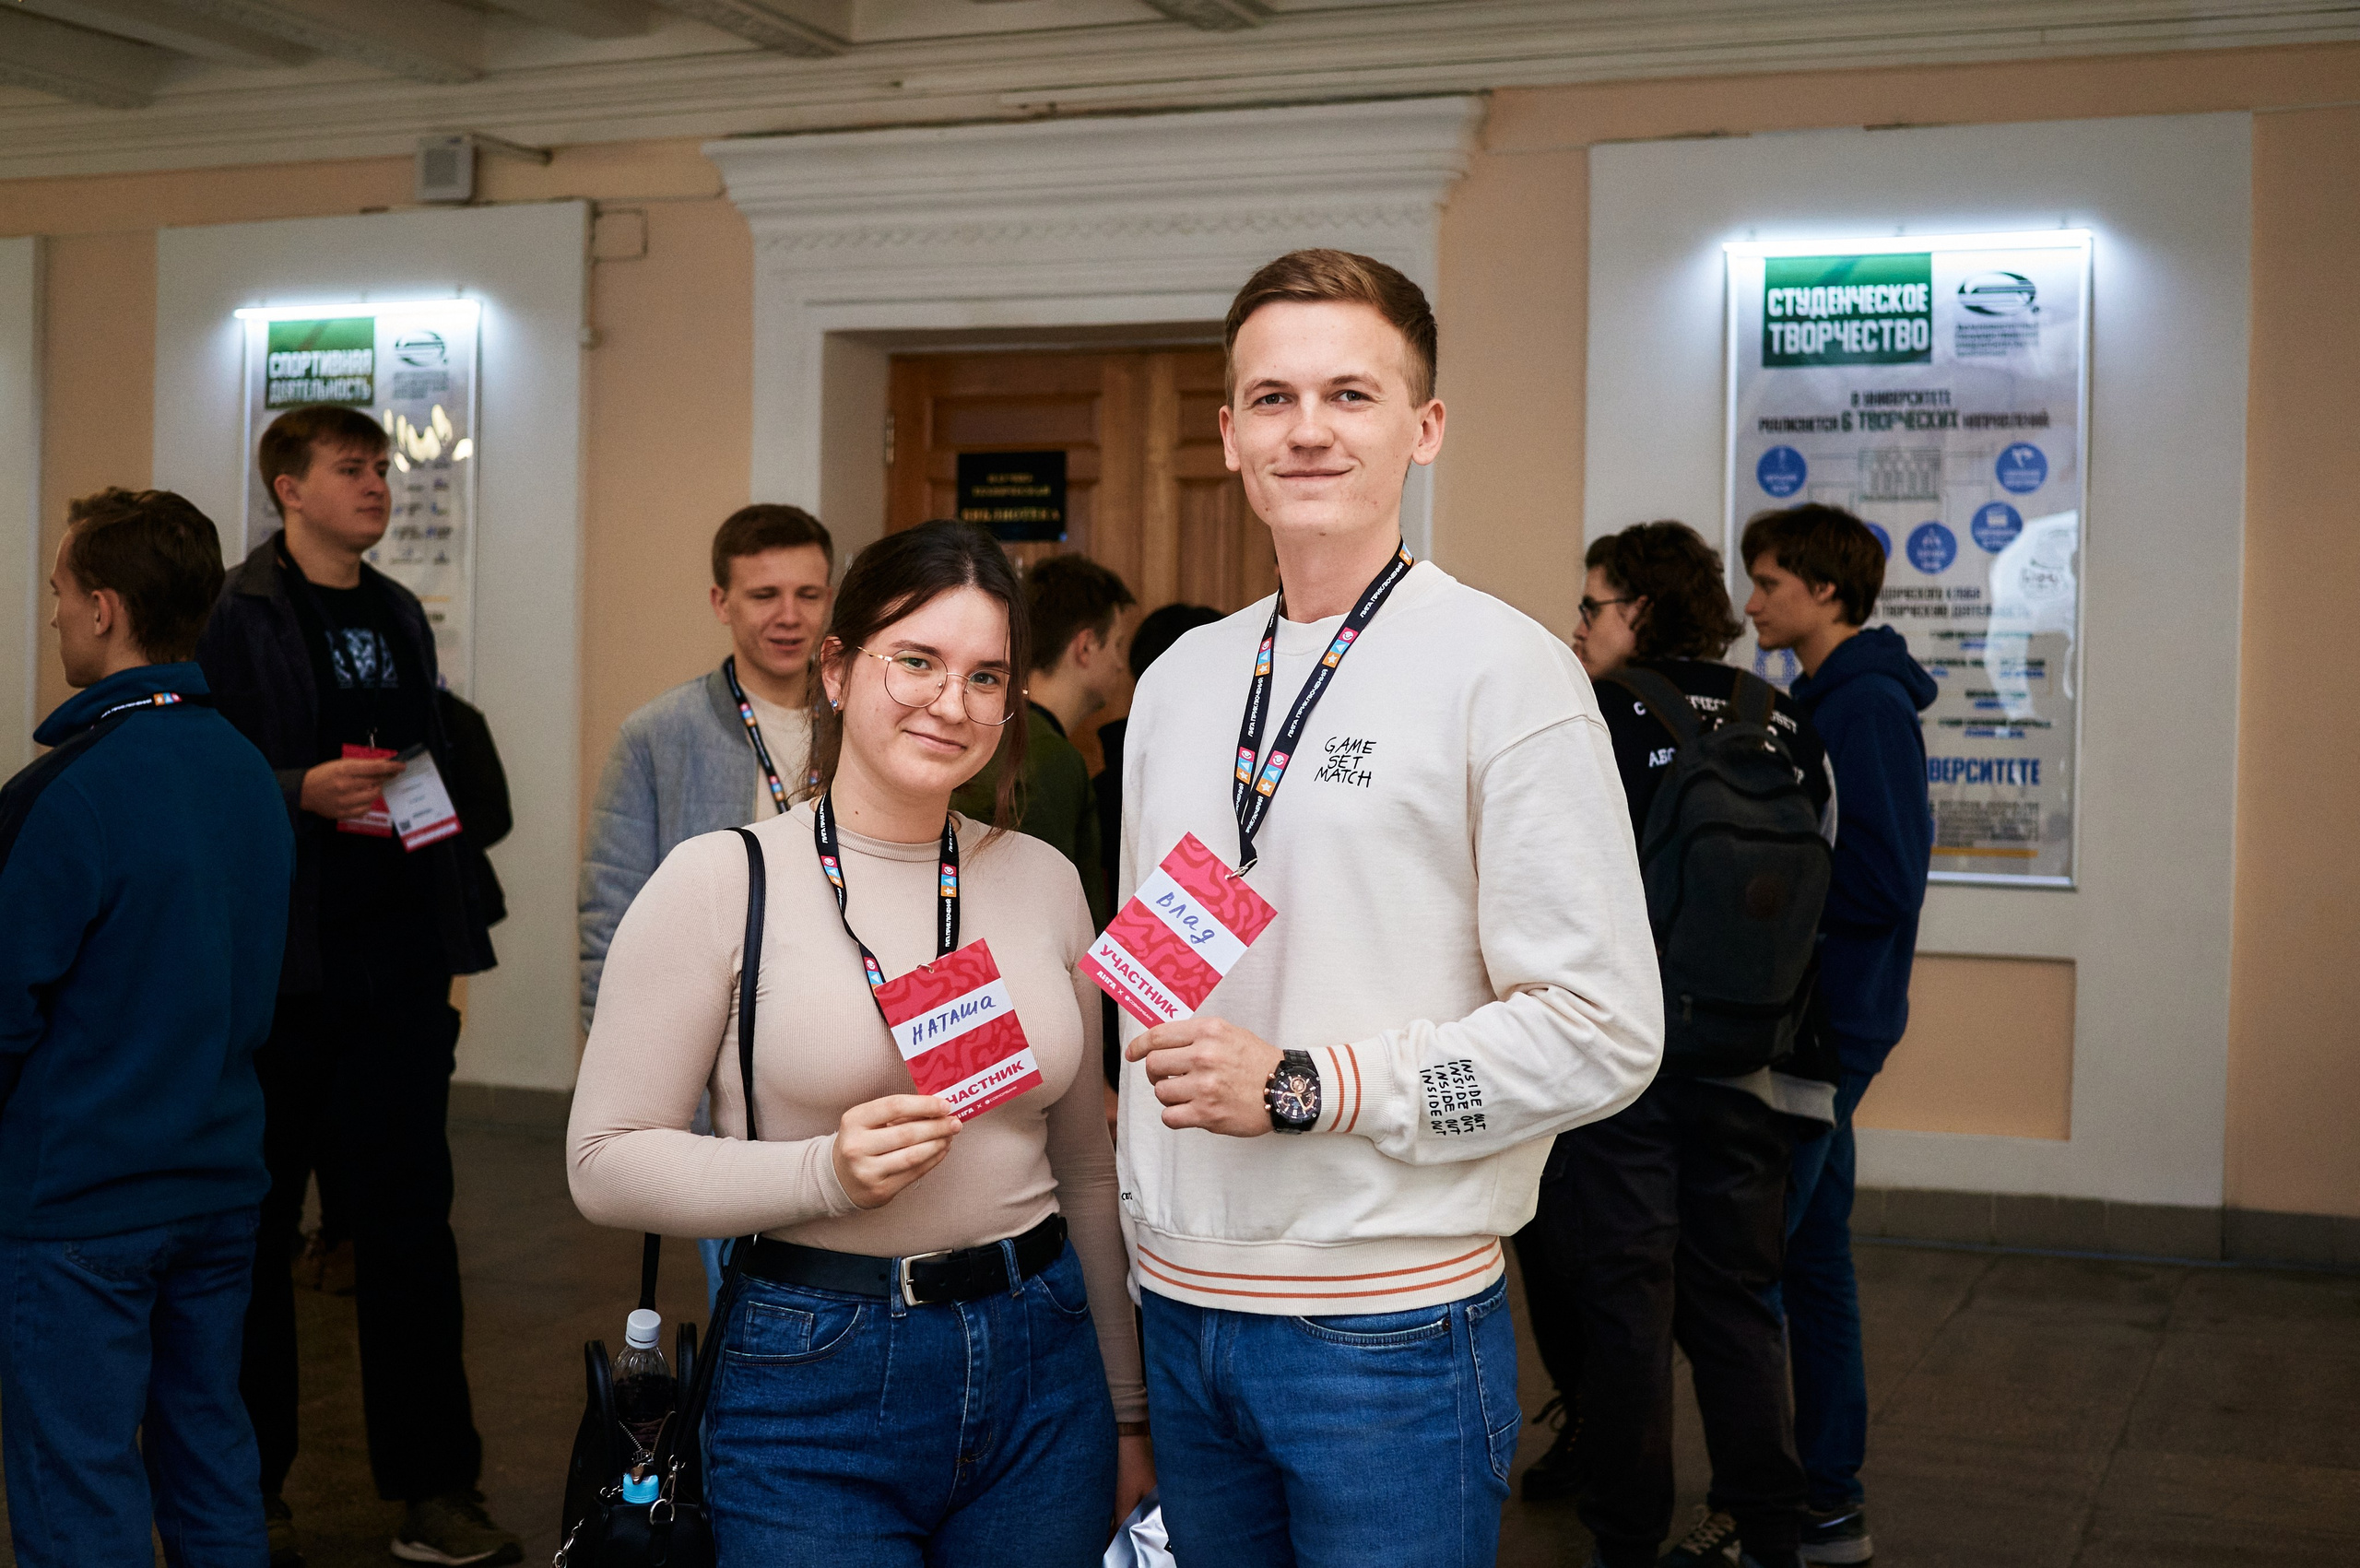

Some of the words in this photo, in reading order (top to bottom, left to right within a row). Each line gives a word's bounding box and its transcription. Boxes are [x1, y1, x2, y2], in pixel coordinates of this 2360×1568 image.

[1767, 282, 1929, 319] СТУДЕНЧЕСКОЕ
[1768, 318, 1929, 355] ТВОРЧЕСТВО
[1324, 737, 1377, 754] GAME
[1328, 754, 1363, 770] SET
[1314, 766, 1372, 788] MATCH
[1927, 756, 2040, 785] ВЕРСИТЕТЕ
[1100, 944, 1179, 1019] УЧАСТНИК
[946, 1060, 1025, 1104] ЧАСТНИК
[1419, 1068, 1443, 1117] INSIDE
[1434, 1065, 1455, 1113] INSIDE
[1445, 1118, 1461, 1136] OUT
[1447, 1061, 1469, 1110] INSIDE
[1460, 1114, 1475, 1133] OUT
[1459, 1059, 1482, 1107] INSIDE
[1473, 1113, 1487, 1130] OUT
[1430, 1120, 1447, 1137] OUT
